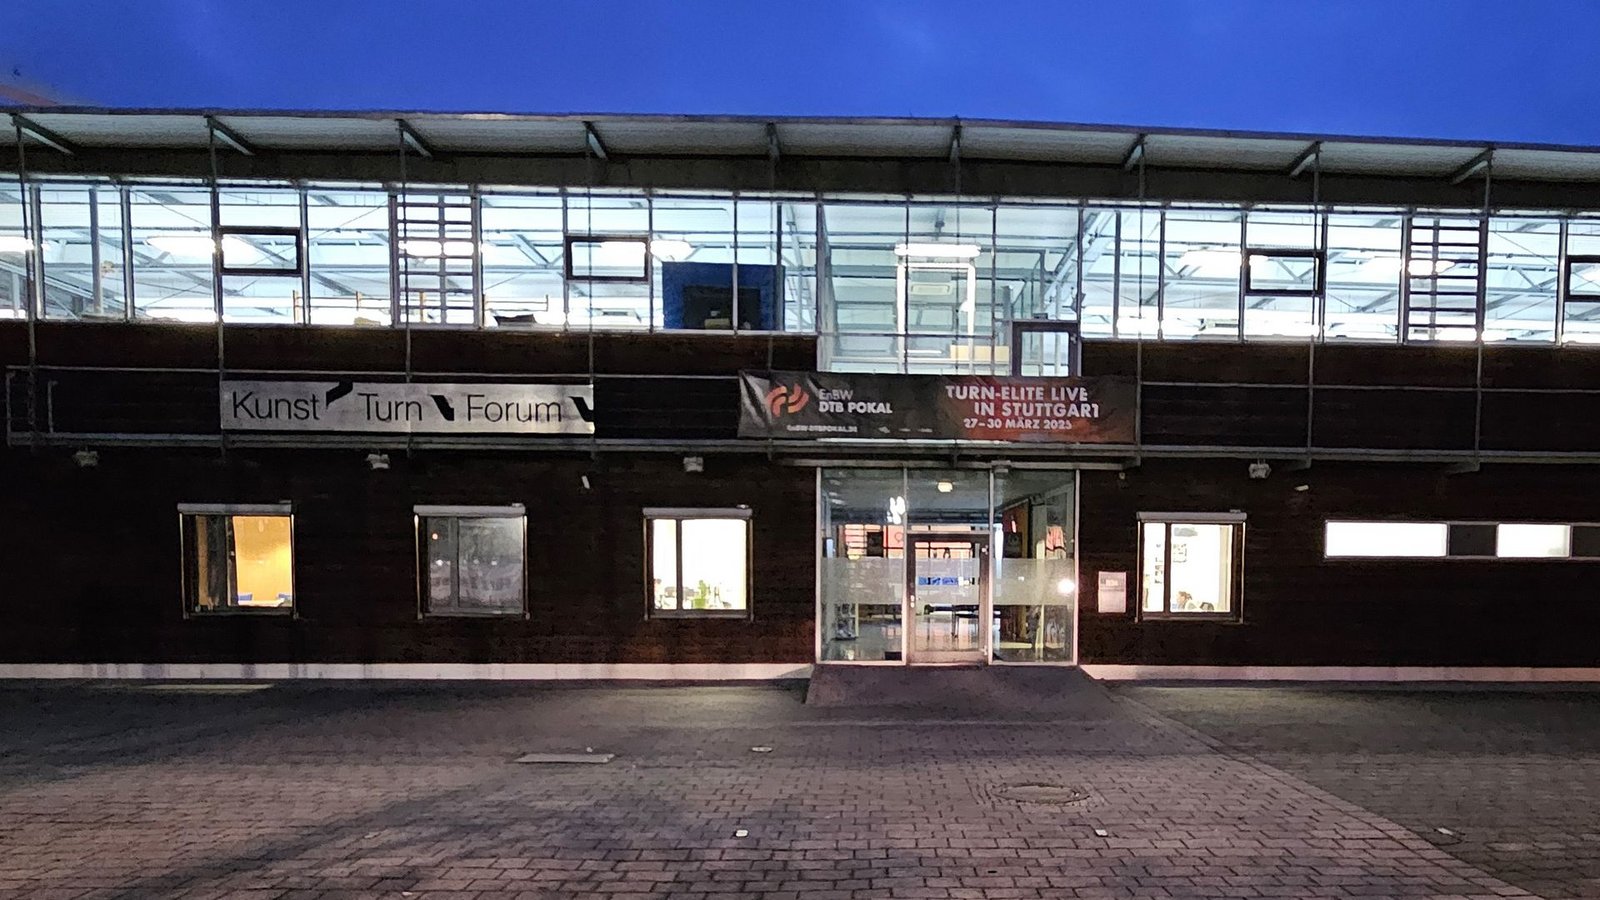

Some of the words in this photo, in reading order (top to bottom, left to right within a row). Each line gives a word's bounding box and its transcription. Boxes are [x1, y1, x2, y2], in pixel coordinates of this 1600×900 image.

[818, 388, 854, 401] EnBW
[945, 385, 1044, 401] TURN-ELITE
[1051, 387, 1088, 402] LIVE
[232, 391, 319, 421] Kunst
[358, 393, 423, 422] Turn
[467, 394, 563, 423] Forum
[818, 401, 844, 413] DTB
[848, 402, 893, 414] POKAL
[974, 402, 995, 417] IN
[1005, 416, 1040, 430] MÄRZ
